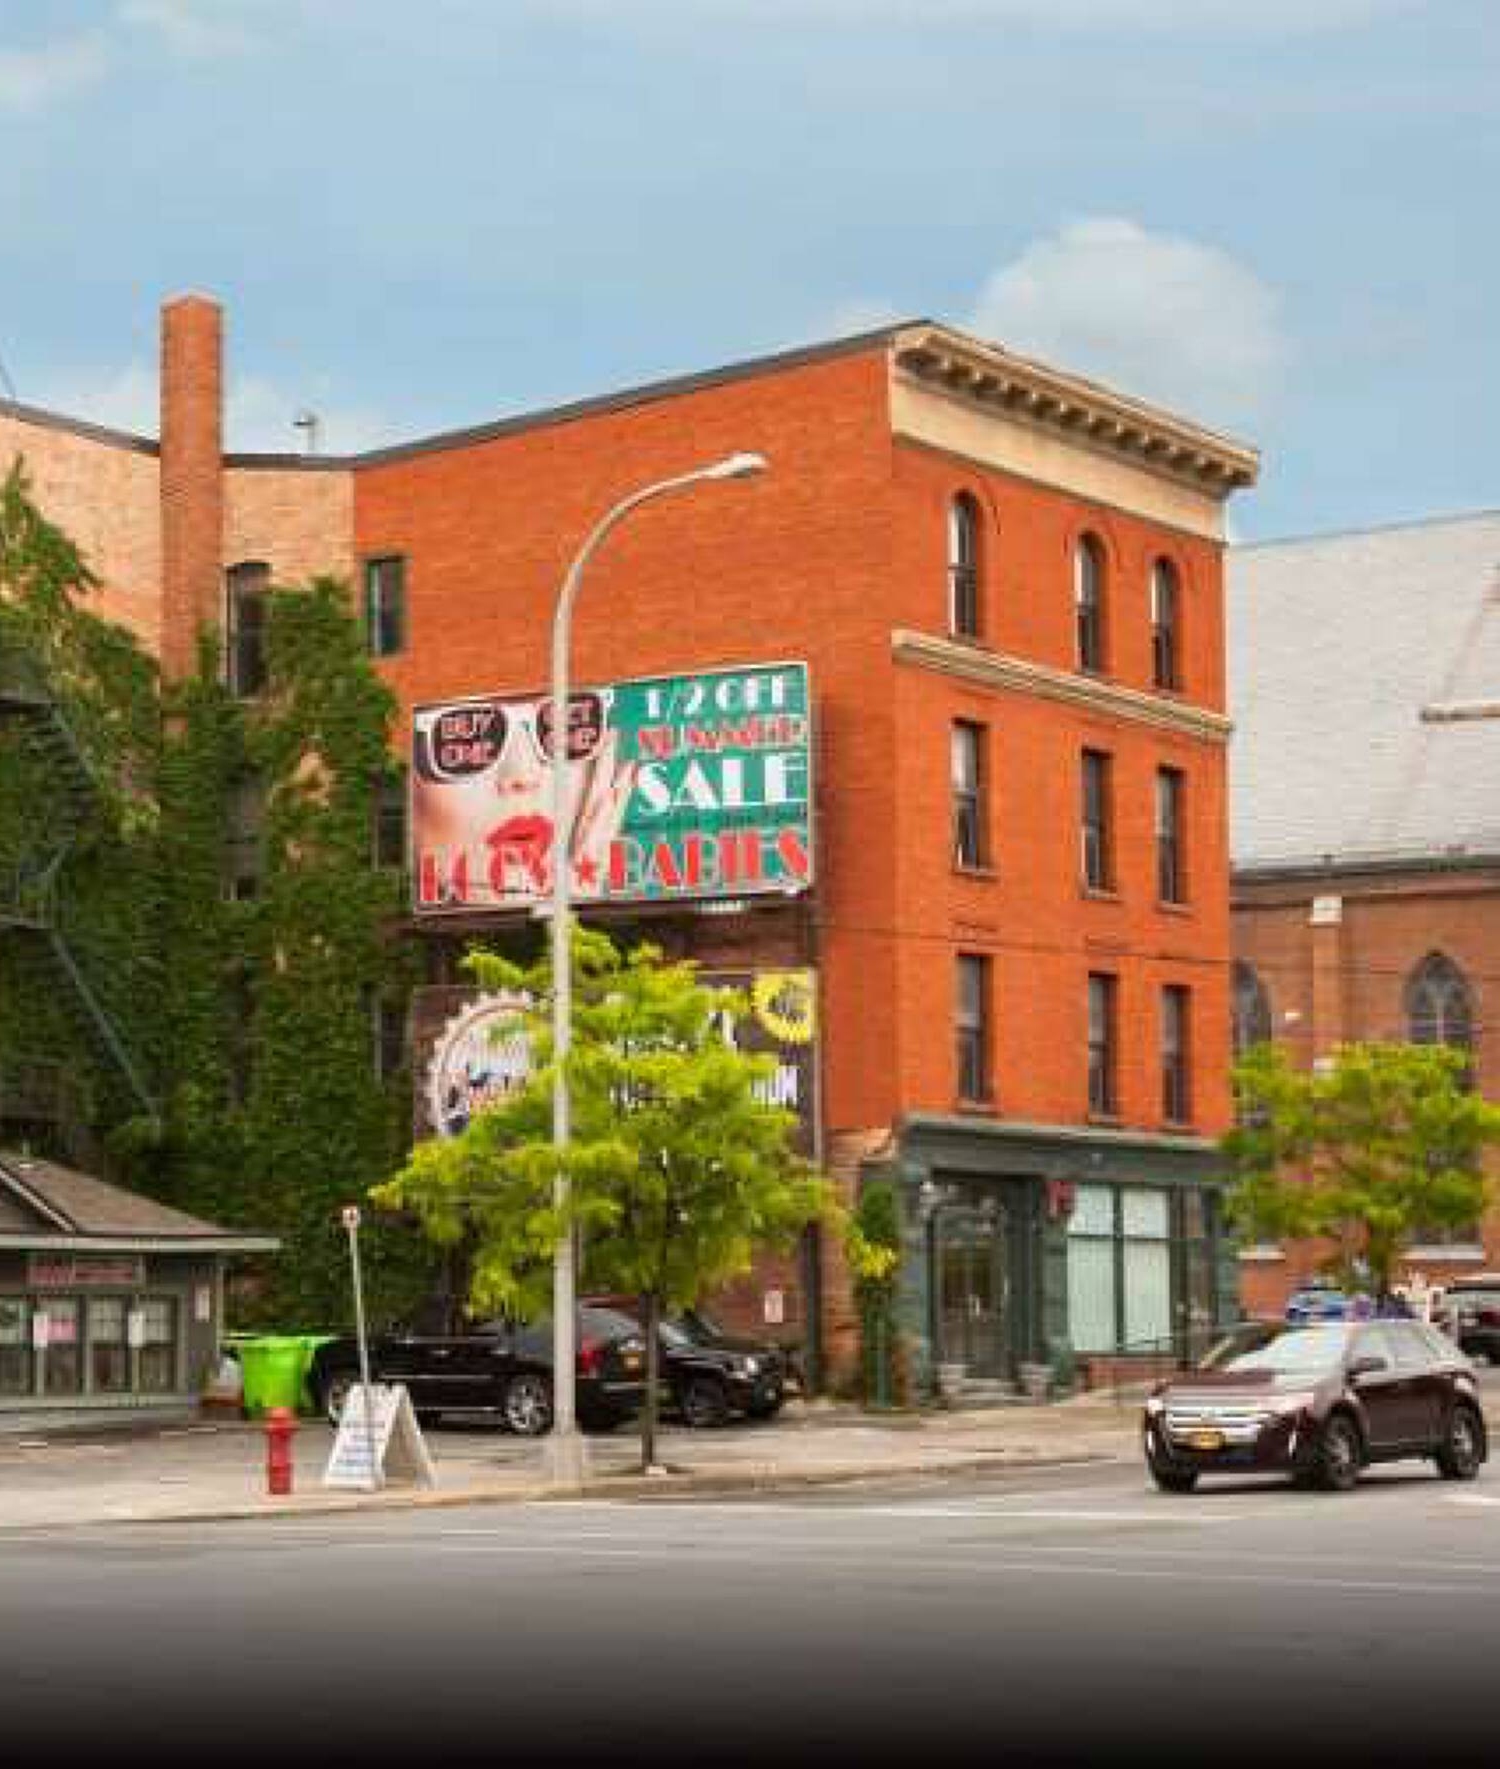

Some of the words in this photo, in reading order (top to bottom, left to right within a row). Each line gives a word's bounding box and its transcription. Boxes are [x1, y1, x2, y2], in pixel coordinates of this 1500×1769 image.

[645, 682, 705, 720] 1/2
[713, 673, 800, 712] OFF
[637, 752, 808, 815] SALE
